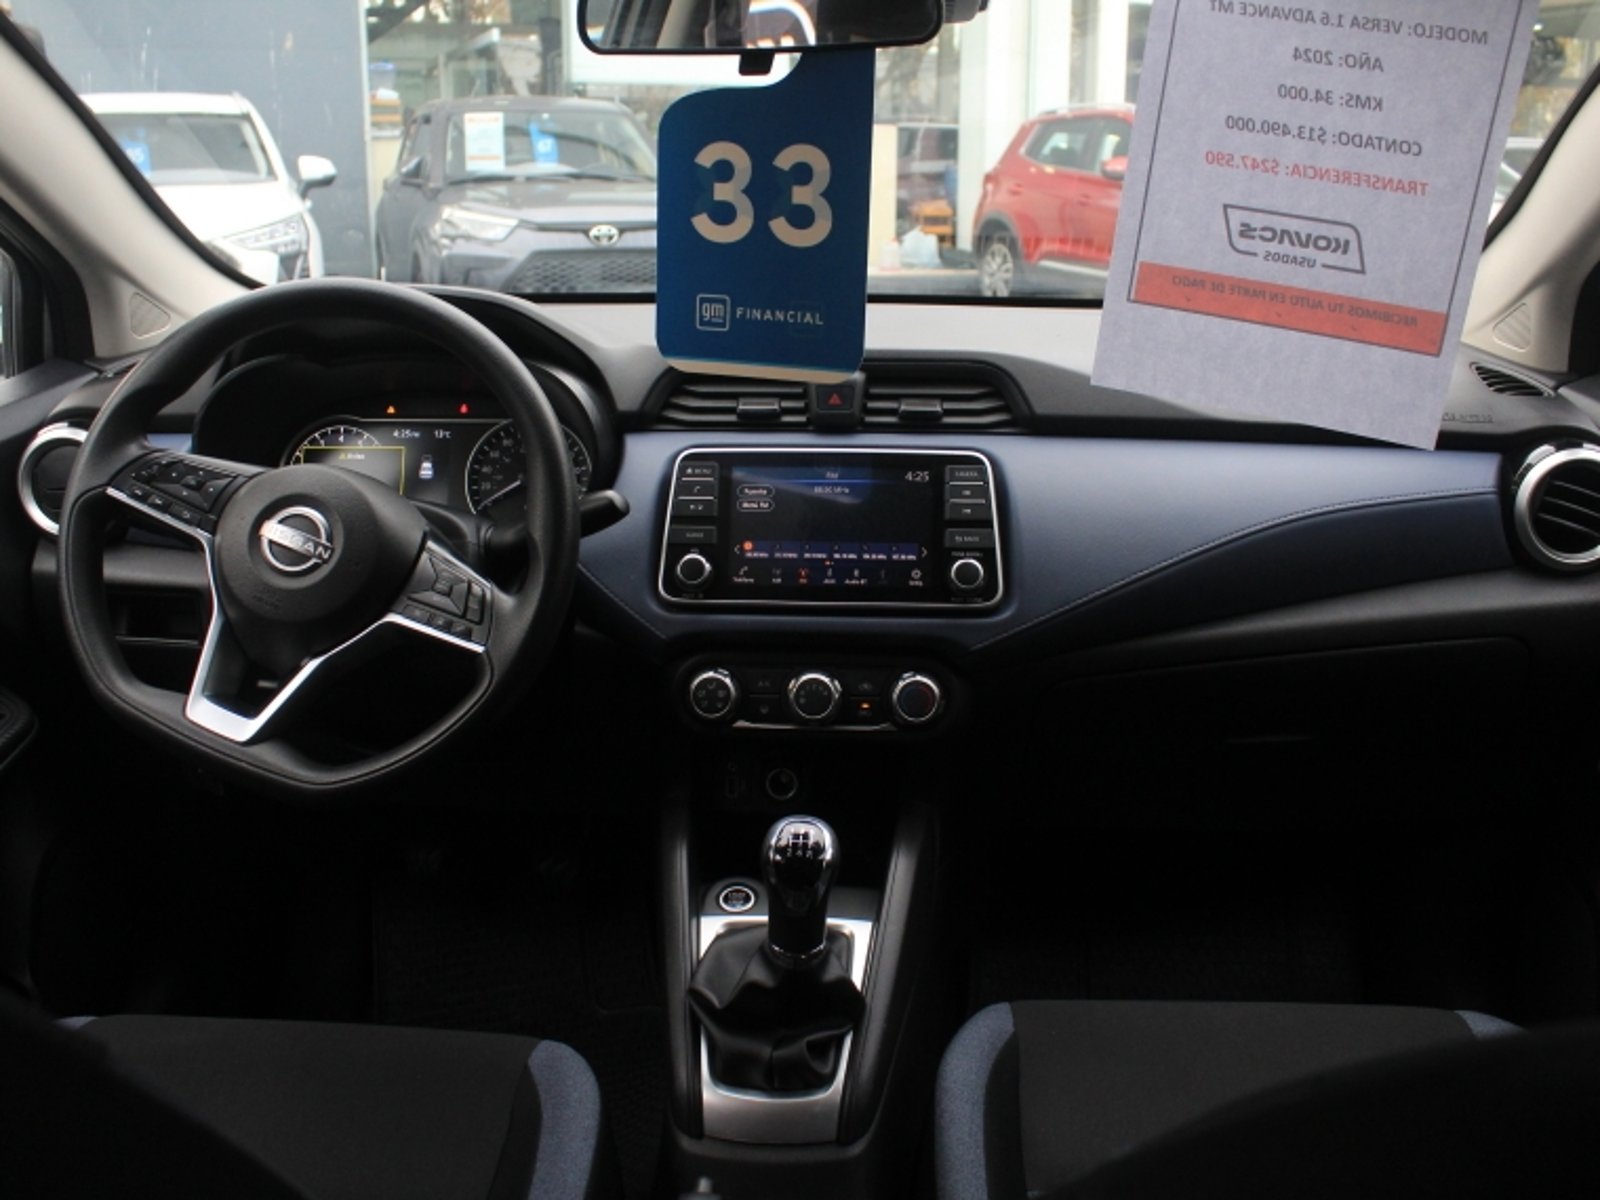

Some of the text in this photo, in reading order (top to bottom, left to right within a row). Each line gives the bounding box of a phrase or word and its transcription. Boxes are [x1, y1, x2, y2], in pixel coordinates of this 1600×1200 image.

[690, 140, 833, 248] 33
[702, 303, 824, 325] gm FINANCIAL
[904, 471, 930, 483] 4:25
